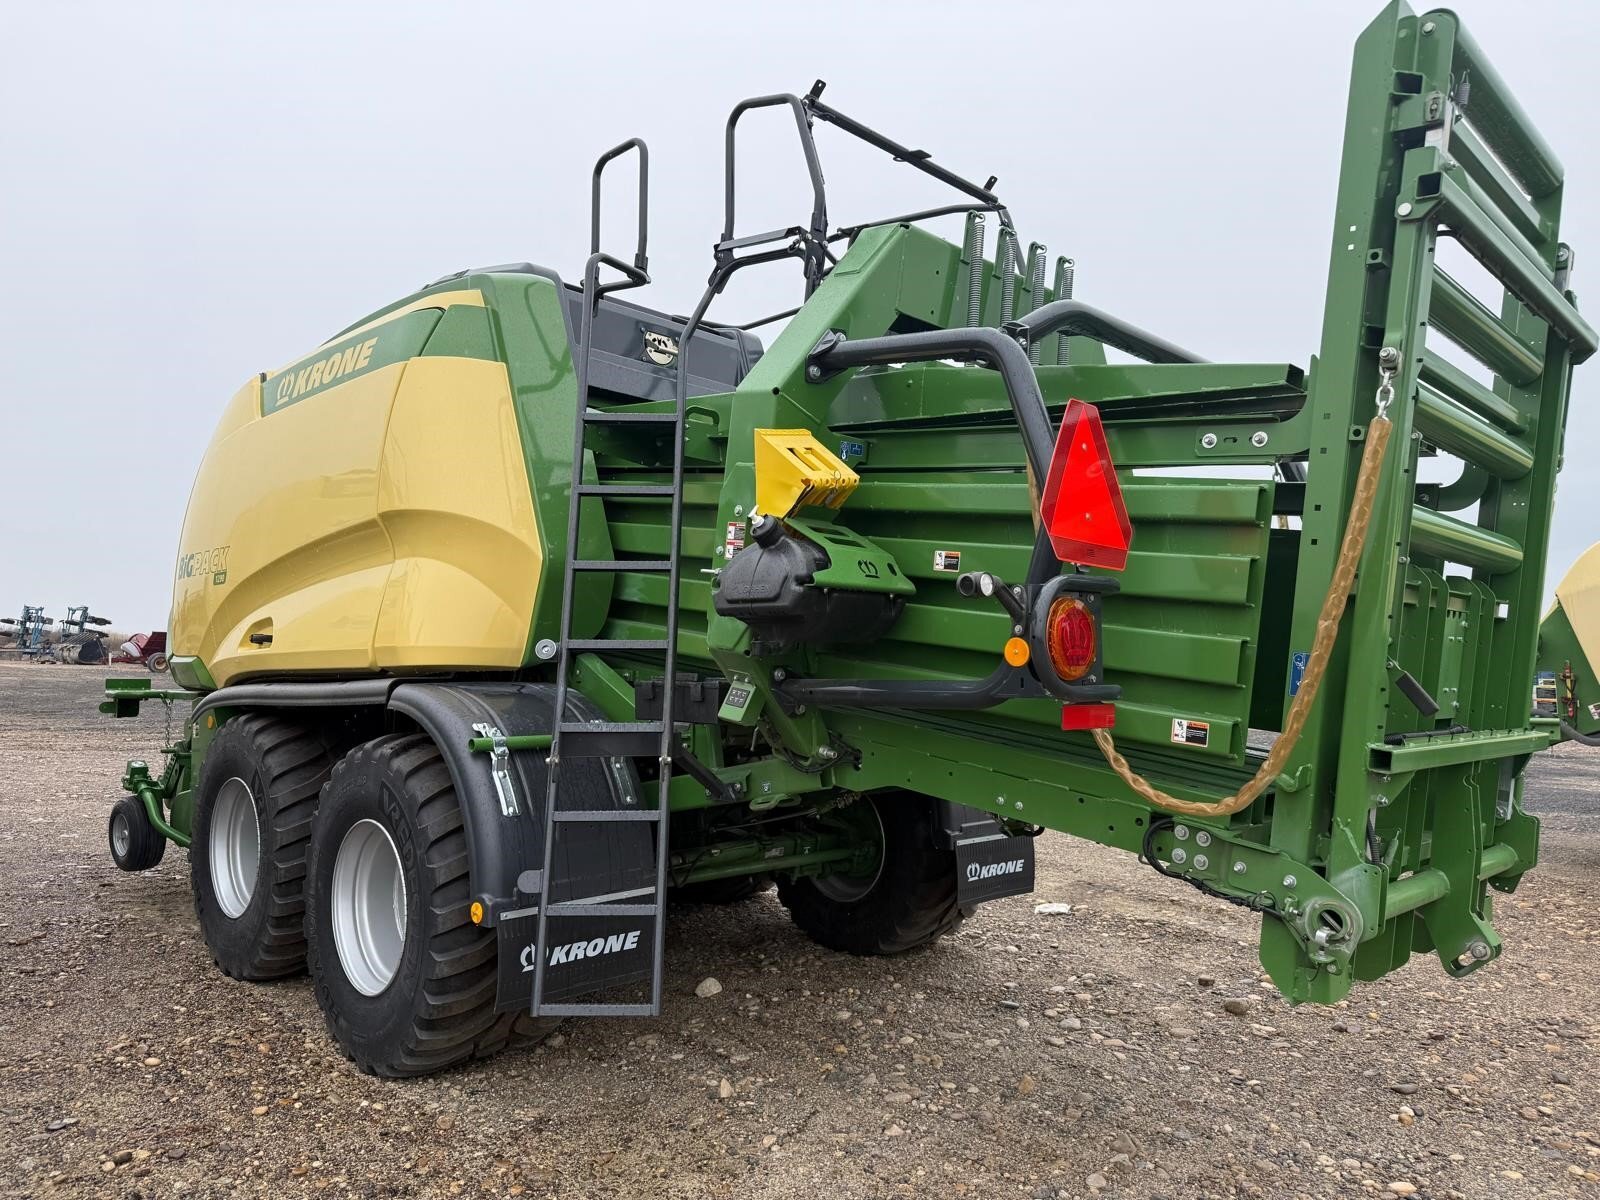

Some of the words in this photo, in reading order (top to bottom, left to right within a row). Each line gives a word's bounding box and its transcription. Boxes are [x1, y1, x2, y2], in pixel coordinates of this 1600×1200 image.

[291, 336, 379, 399] KRONE
[979, 858, 1025, 880] KRONE
[549, 930, 641, 967] KRONE
